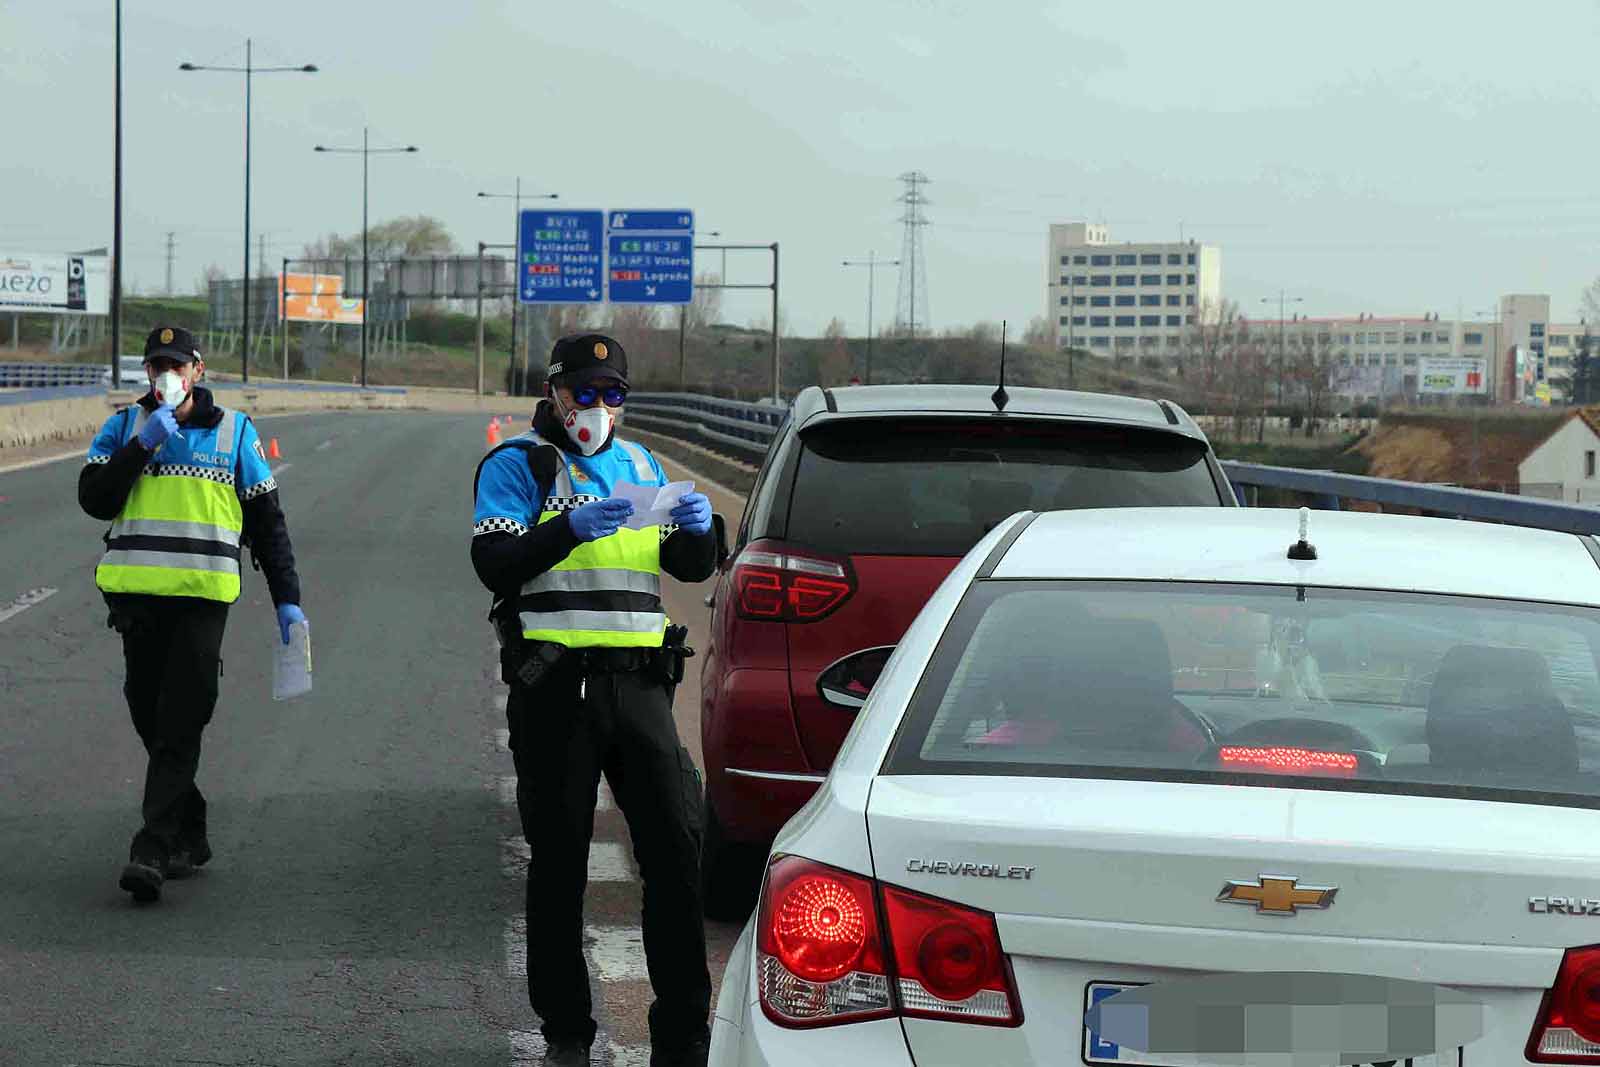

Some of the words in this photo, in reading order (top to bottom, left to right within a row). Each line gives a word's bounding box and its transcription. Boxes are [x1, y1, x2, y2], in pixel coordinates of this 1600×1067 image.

[534, 242, 590, 252] Valladolid
[563, 253, 599, 264] Madrid
[655, 255, 690, 265] Vitoria
[564, 265, 594, 275] Soria
[564, 277, 593, 288] León
[906, 857, 1037, 880] CHEVROLET
